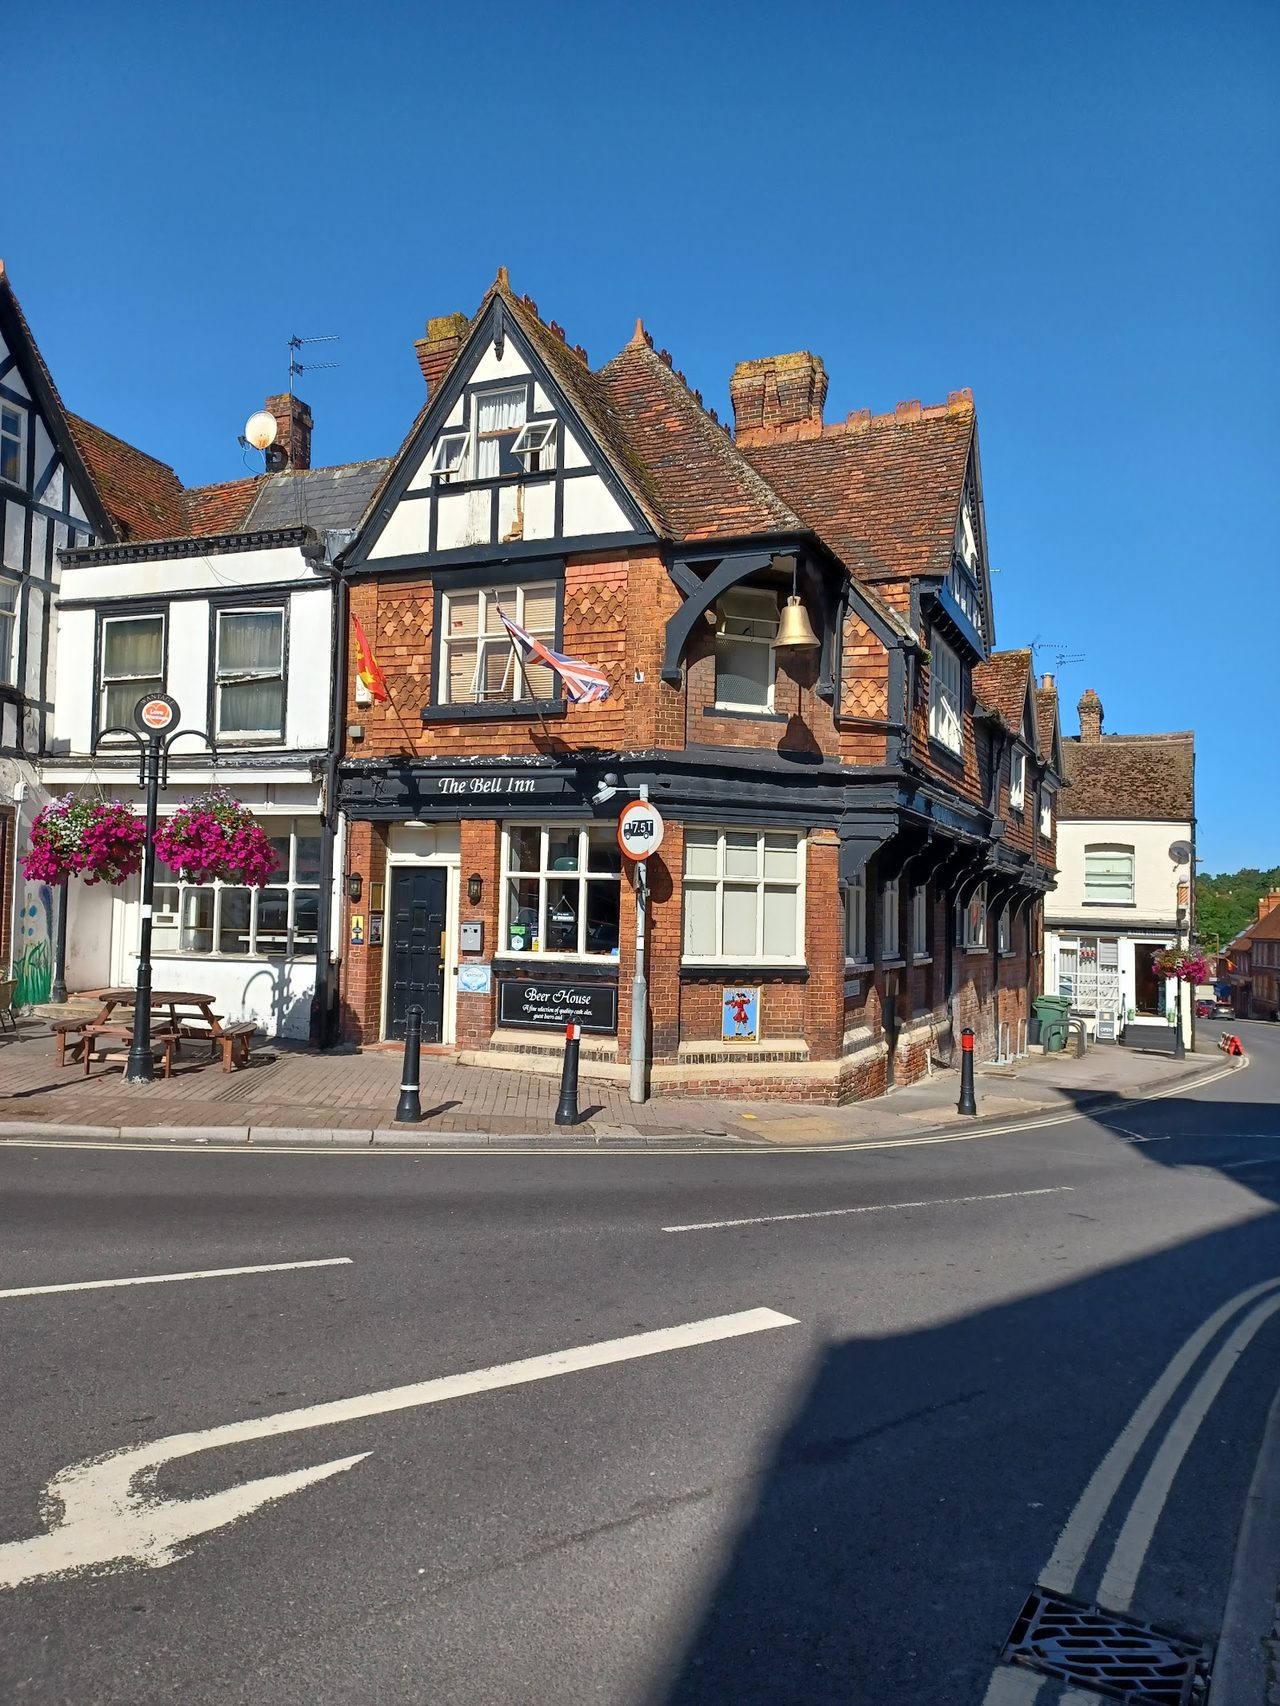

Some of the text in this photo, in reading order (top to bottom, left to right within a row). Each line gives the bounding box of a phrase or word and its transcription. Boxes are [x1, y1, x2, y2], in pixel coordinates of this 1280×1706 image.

[140, 694, 175, 704] WANTAGE
[438, 777, 535, 794] The Bell Inn
[632, 821, 653, 834] 7.5T
[524, 988, 591, 1004] Beer House
[554, 1006, 560, 1015] of
